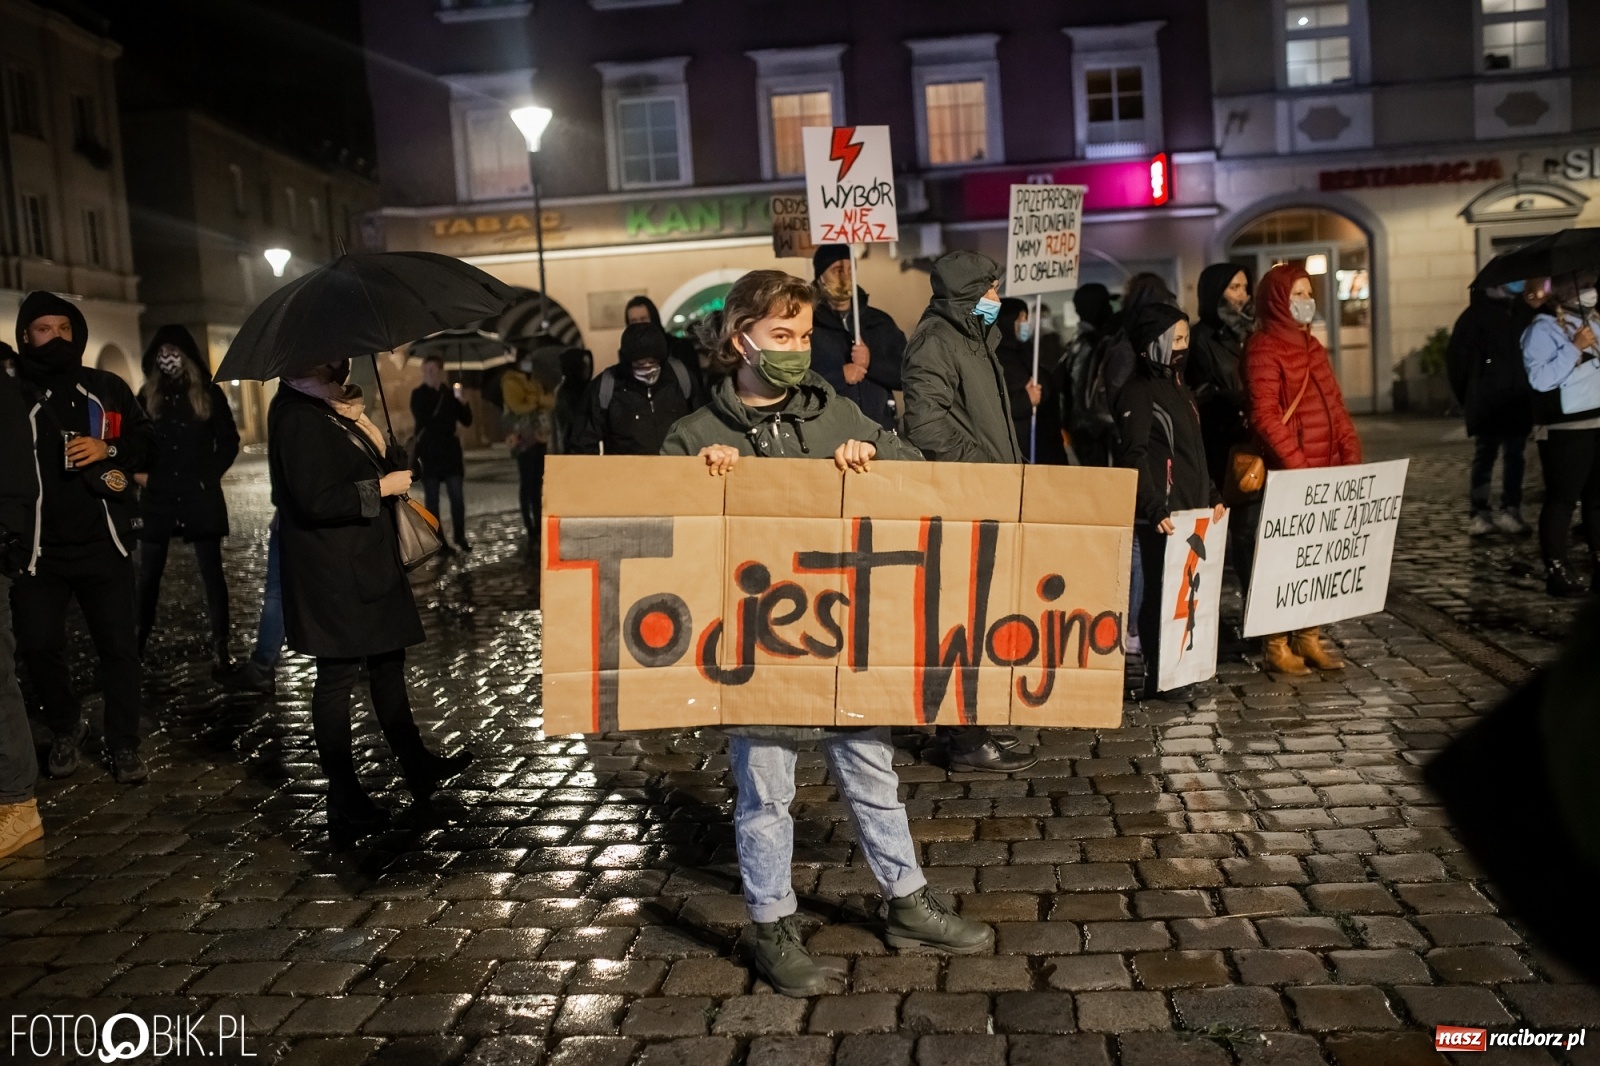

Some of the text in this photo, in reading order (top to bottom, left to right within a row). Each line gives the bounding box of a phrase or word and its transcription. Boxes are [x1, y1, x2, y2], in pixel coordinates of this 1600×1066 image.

[821, 176, 894, 210] WYBÓR
[843, 207, 874, 225] NIE
[819, 222, 896, 244] ZAKAZ
[1016, 239, 1042, 259] MAMY
[1013, 263, 1028, 283] DO
[1305, 475, 1376, 506] BEZ KOBIET
[1264, 495, 1402, 539] DALEKO NIE ZAJDZIECIE
[1295, 534, 1371, 568] BEZ KOBIET
[1276, 566, 1366, 609] WYGINIECIE
[547, 516, 1124, 733] To jest Wojna
